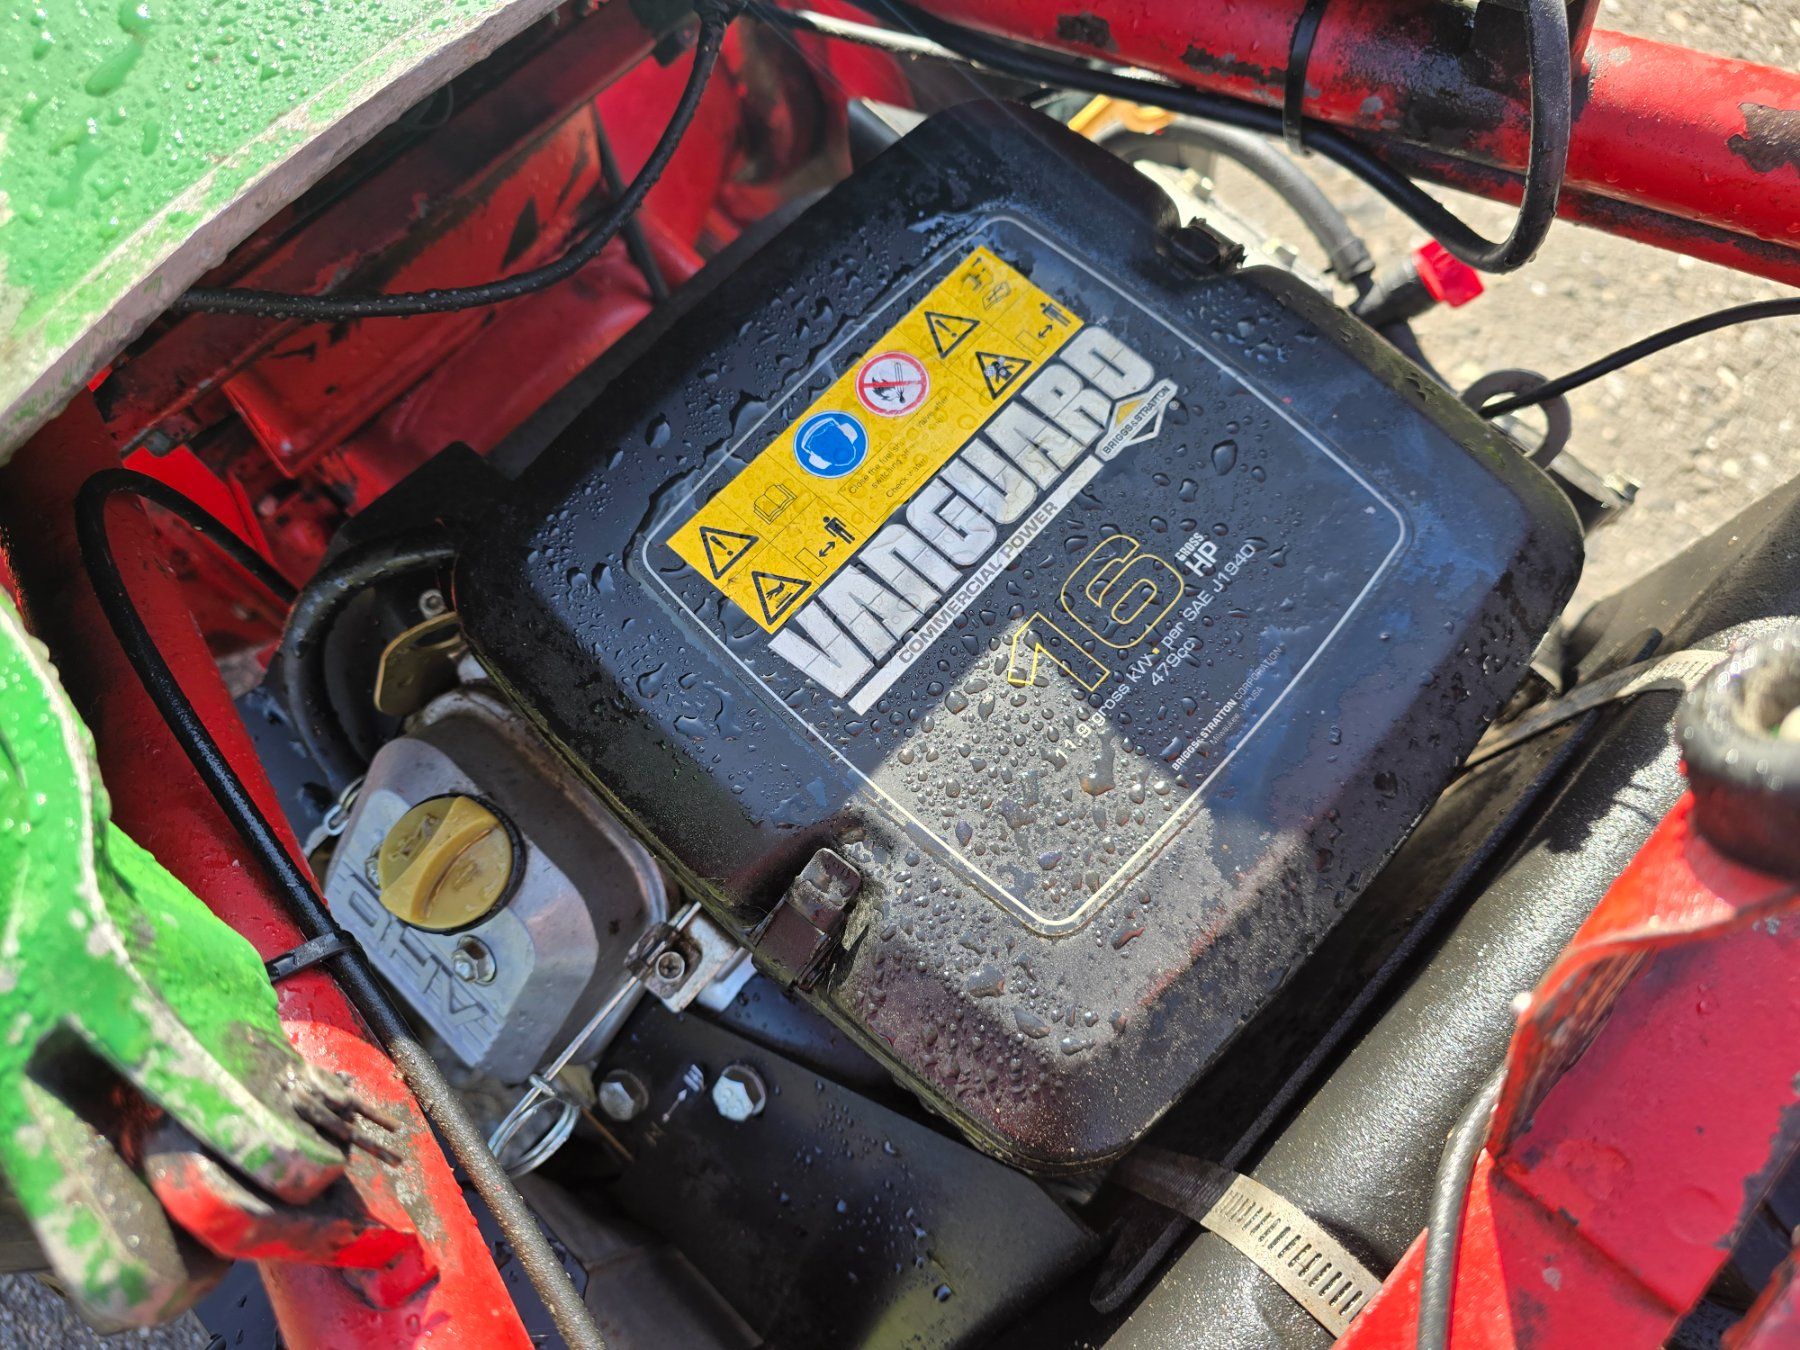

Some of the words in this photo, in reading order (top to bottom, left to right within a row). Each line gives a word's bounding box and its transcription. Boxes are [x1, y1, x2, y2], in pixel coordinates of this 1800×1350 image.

[848, 473, 869, 495] Close
[867, 462, 880, 475] the
[878, 449, 893, 464] fuel
[871, 458, 903, 489] switching
[884, 474, 908, 498] Check
[767, 325, 1155, 697] VANGUARD
[1173, 531, 1205, 562] GROSS
[1184, 540, 1216, 577] HP
[897, 557, 1002, 664] COMMERCIAL
[999, 500, 1058, 559] POWER
[1008, 531, 1185, 691] 16
[1089, 681, 1130, 726] gross
[1124, 652, 1154, 683] kW
[1161, 620, 1187, 650] per
[1182, 589, 1213, 622] SAE
[1207, 541, 1257, 593] J1940
[1147, 637, 1196, 687] 479cc
[1233, 646, 1282, 700] CORPORATION
[328, 871, 489, 1028] OHV
